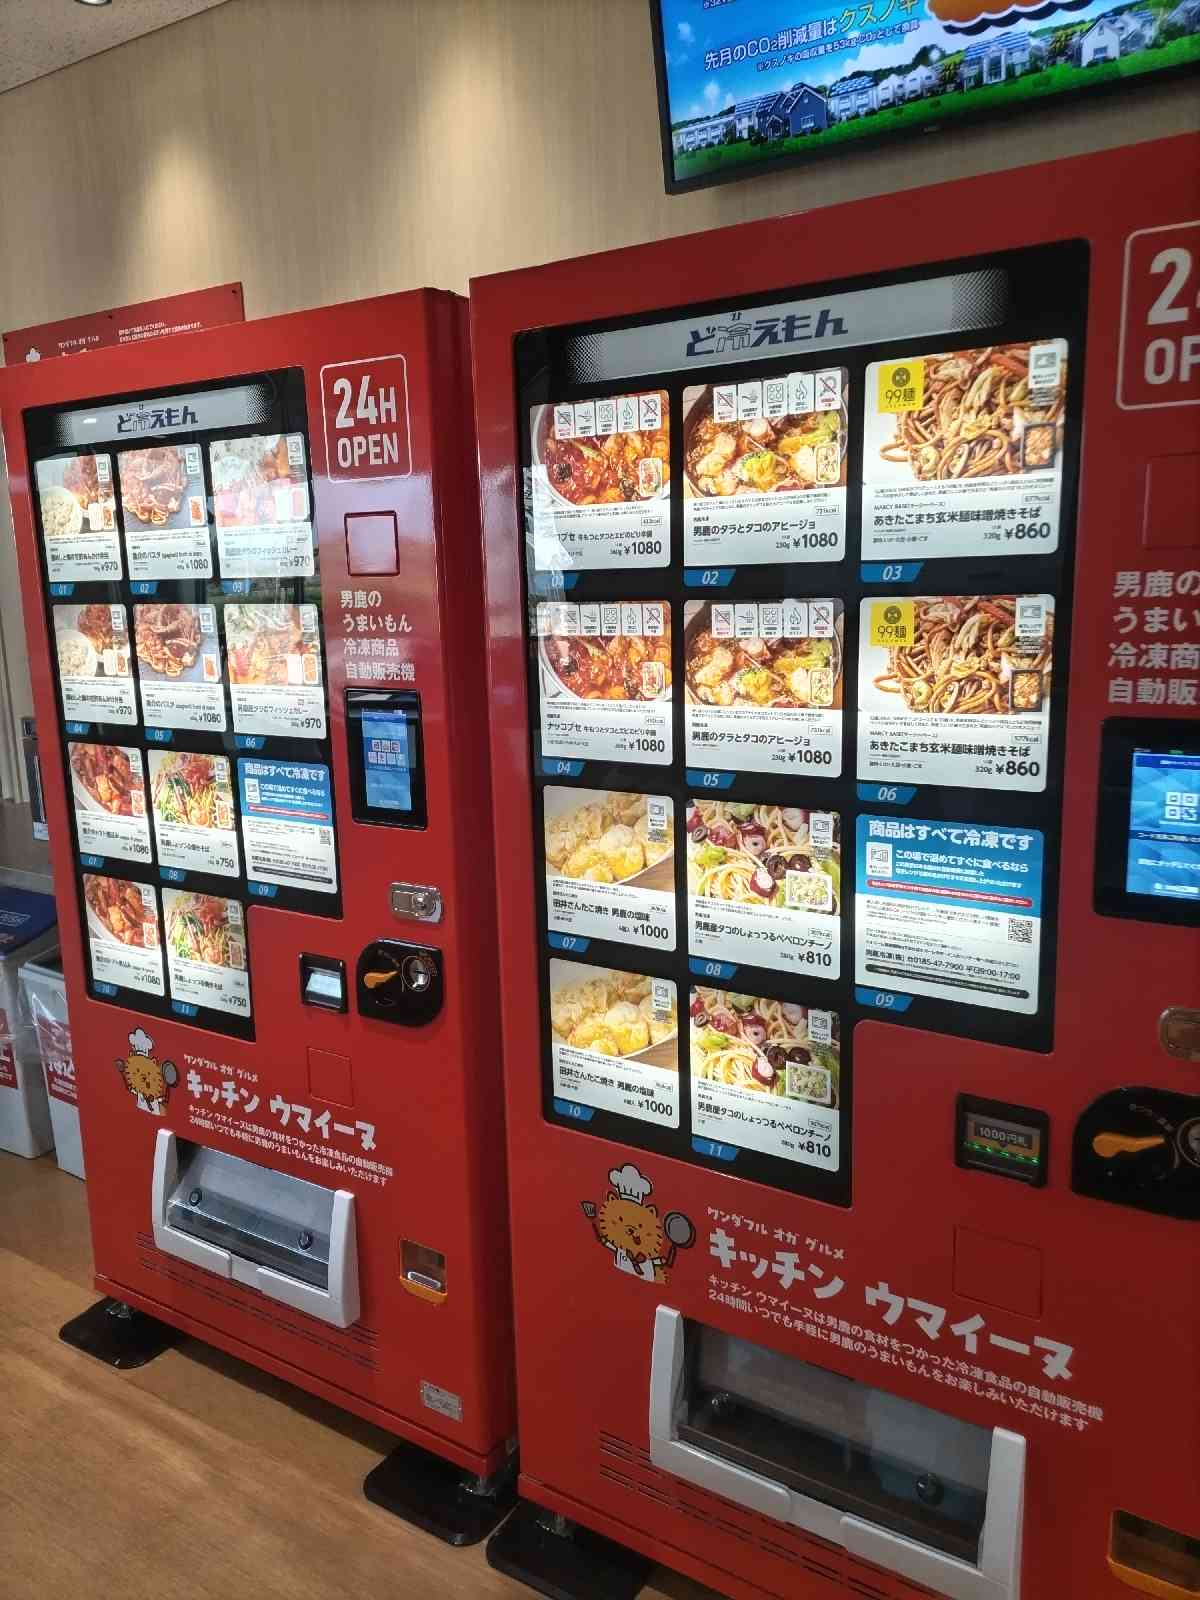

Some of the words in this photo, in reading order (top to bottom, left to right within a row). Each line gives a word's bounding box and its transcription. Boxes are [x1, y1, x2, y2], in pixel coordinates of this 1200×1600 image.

[1147, 247, 1200, 326] 2
[333, 374, 398, 429] 24H
[336, 432, 399, 468] OPEN
[692, 519, 816, 537] 男鹿のタラとタコのアヒージョ
[1004, 522, 1051, 541] ¥860
[623, 540, 662, 555] ¥1080
[792, 532, 838, 549] ¥1080
[702, 571, 719, 585] 02
[882, 565, 903, 581] 03
[1113, 570, 1200, 599] 男鹿の
[339, 590, 382, 609] 男鹿の
[341, 614, 413, 633] うまいもん
[343, 638, 400, 657] 冷凍商品
[1107, 642, 1200, 670] 冷凍商
[345, 662, 416, 682] 自動販売機
[1107, 677, 1200, 706] 自動販
[300, 717, 322, 729] ¥970
[628, 738, 665, 752] ¥1080
[691, 731, 811, 747] 男鹿のタラとタコのアヒージョ
[788, 749, 832, 765] ¥1080
[556, 761, 570, 773] 04
[995, 760, 1040, 776] ¥860
[703, 773, 719, 786] 05
[877, 787, 897, 801] 06
[868, 819, 1034, 851] 商品はすべて冷凍です
[215, 858, 235, 869] ¥750
[632, 923, 669, 939] ¥1000
[694, 920, 833, 950] 男鹿産タコのしょっつるペペロンチーノ
[562, 937, 577, 949] 07
[797, 950, 832, 967] ¥810
[704, 962, 722, 976] 08
[874, 993, 895, 1008] 09
[186, 1068, 260, 1113] キッチン
[269, 1094, 377, 1150] ウマイーヌ
[568, 1104, 581, 1117] 10
[637, 1099, 673, 1117] ¥1000
[697, 1101, 832, 1142] 男鹿産タコのしょっつるペペロンチーノ
[708, 1143, 722, 1157] 11
[797, 1140, 832, 1158] ¥810
[707, 1207, 768, 1235] ワンダフル
[773, 1227, 799, 1246] オガ
[805, 1237, 845, 1260] グルメ
[709, 1227, 845, 1299] キッチン
[864, 1281, 1074, 1381] ウマイーヌ
[708, 1273, 752, 1297] キッチン
[755, 1289, 1104, 1422] ウマイーヌは男鹿の食材をつかった冷凍食品の自動販売機
[708, 1288, 1090, 1432] 24時間いつでも手軽に男鹿のうまいもんをお楽しみいただけます
